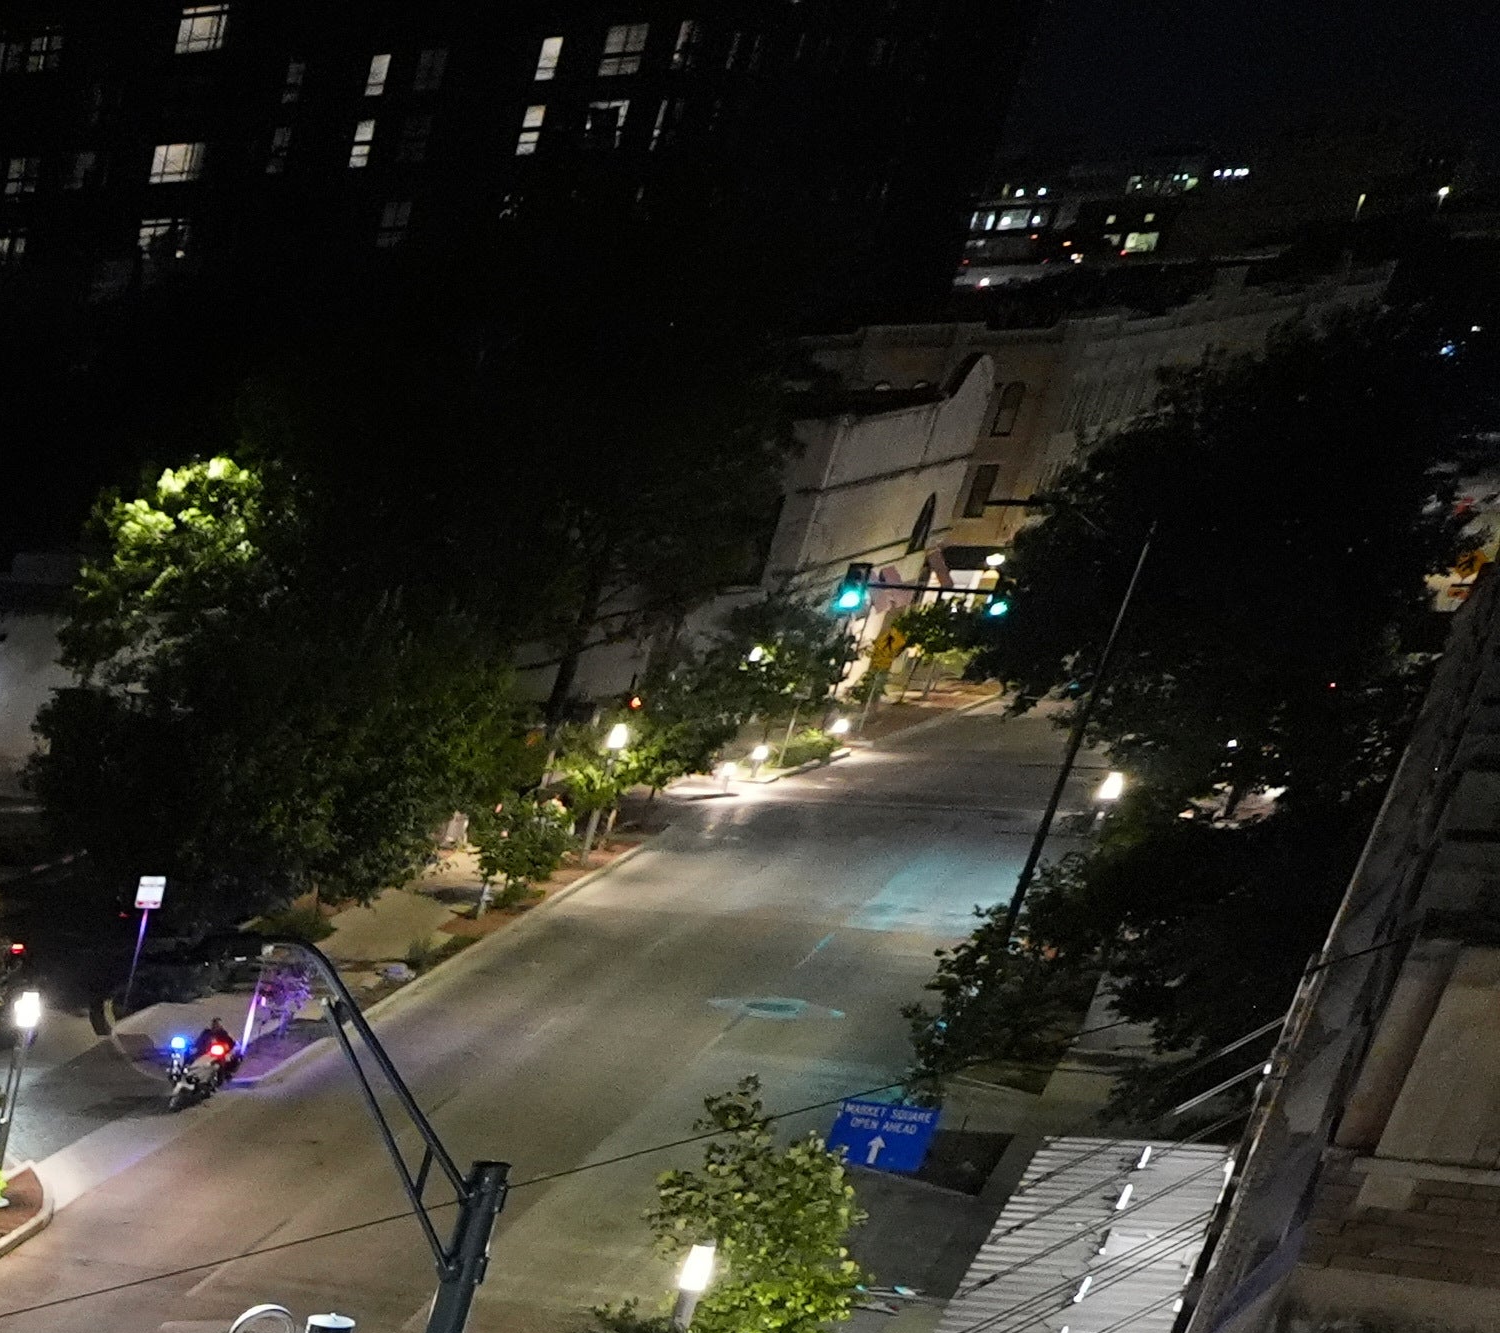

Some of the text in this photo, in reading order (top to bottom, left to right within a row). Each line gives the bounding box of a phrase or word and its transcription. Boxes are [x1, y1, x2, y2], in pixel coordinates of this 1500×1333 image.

[845, 1103, 934, 1124] MARKET SQUARE
[850, 1116, 879, 1131] OPEN
